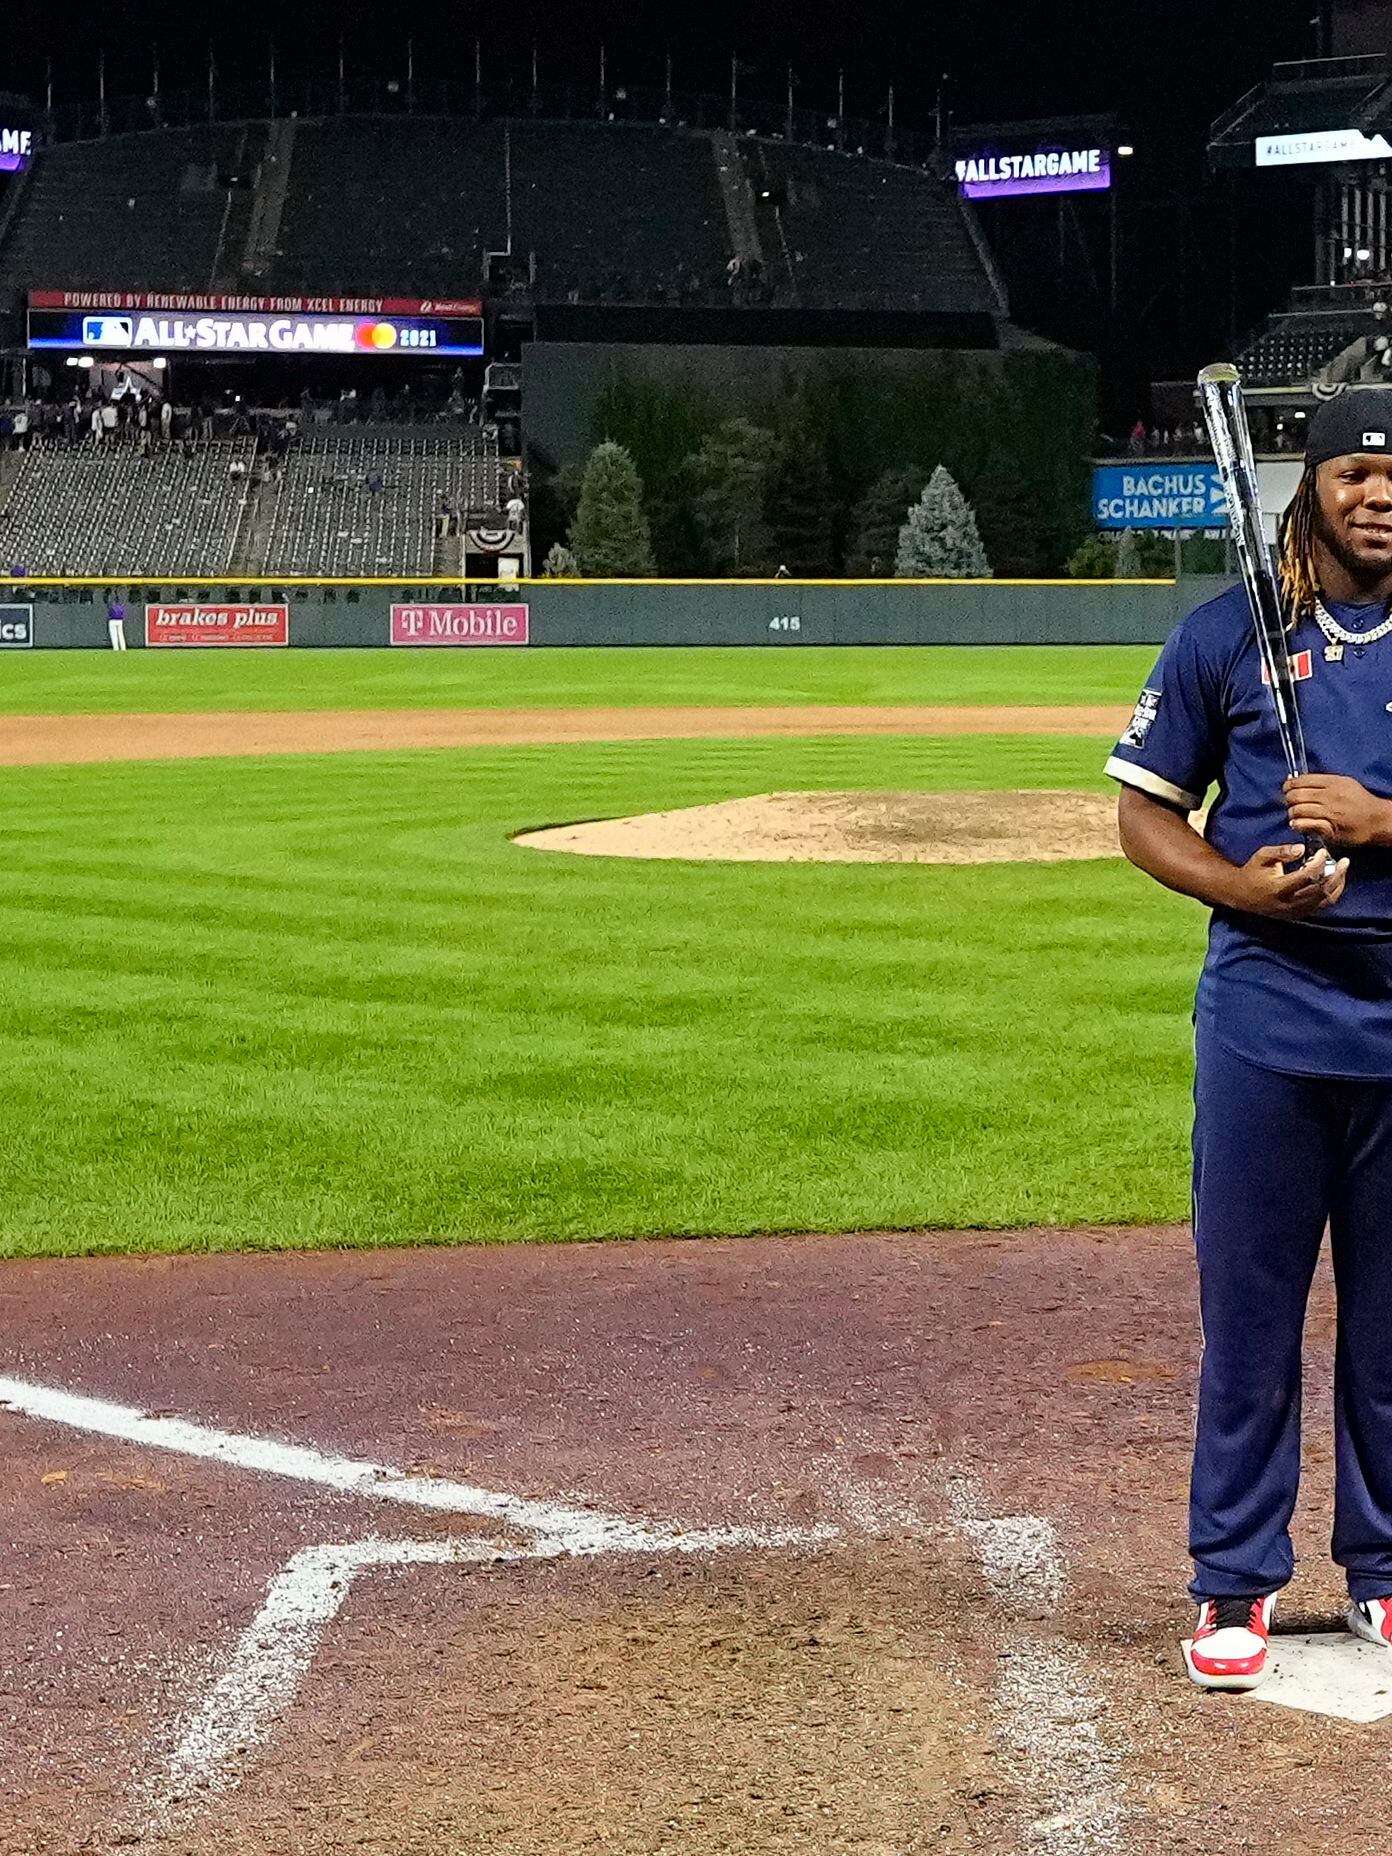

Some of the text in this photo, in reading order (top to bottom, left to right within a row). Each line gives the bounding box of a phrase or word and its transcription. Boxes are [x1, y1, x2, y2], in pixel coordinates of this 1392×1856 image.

[64, 292, 383, 313] POWERED BY RENEWABLE ENERGY FROM XCEL ENERGY
[400, 329, 437, 347] 2021
[1122, 474, 1206, 497] BACHUS
[1097, 497, 1206, 520] SCHANKER
[156, 608, 278, 629] brakes plus
[429, 609, 518, 636] Mobile
[768, 616, 801, 631] 415
[0, 619, 27, 640] cs
